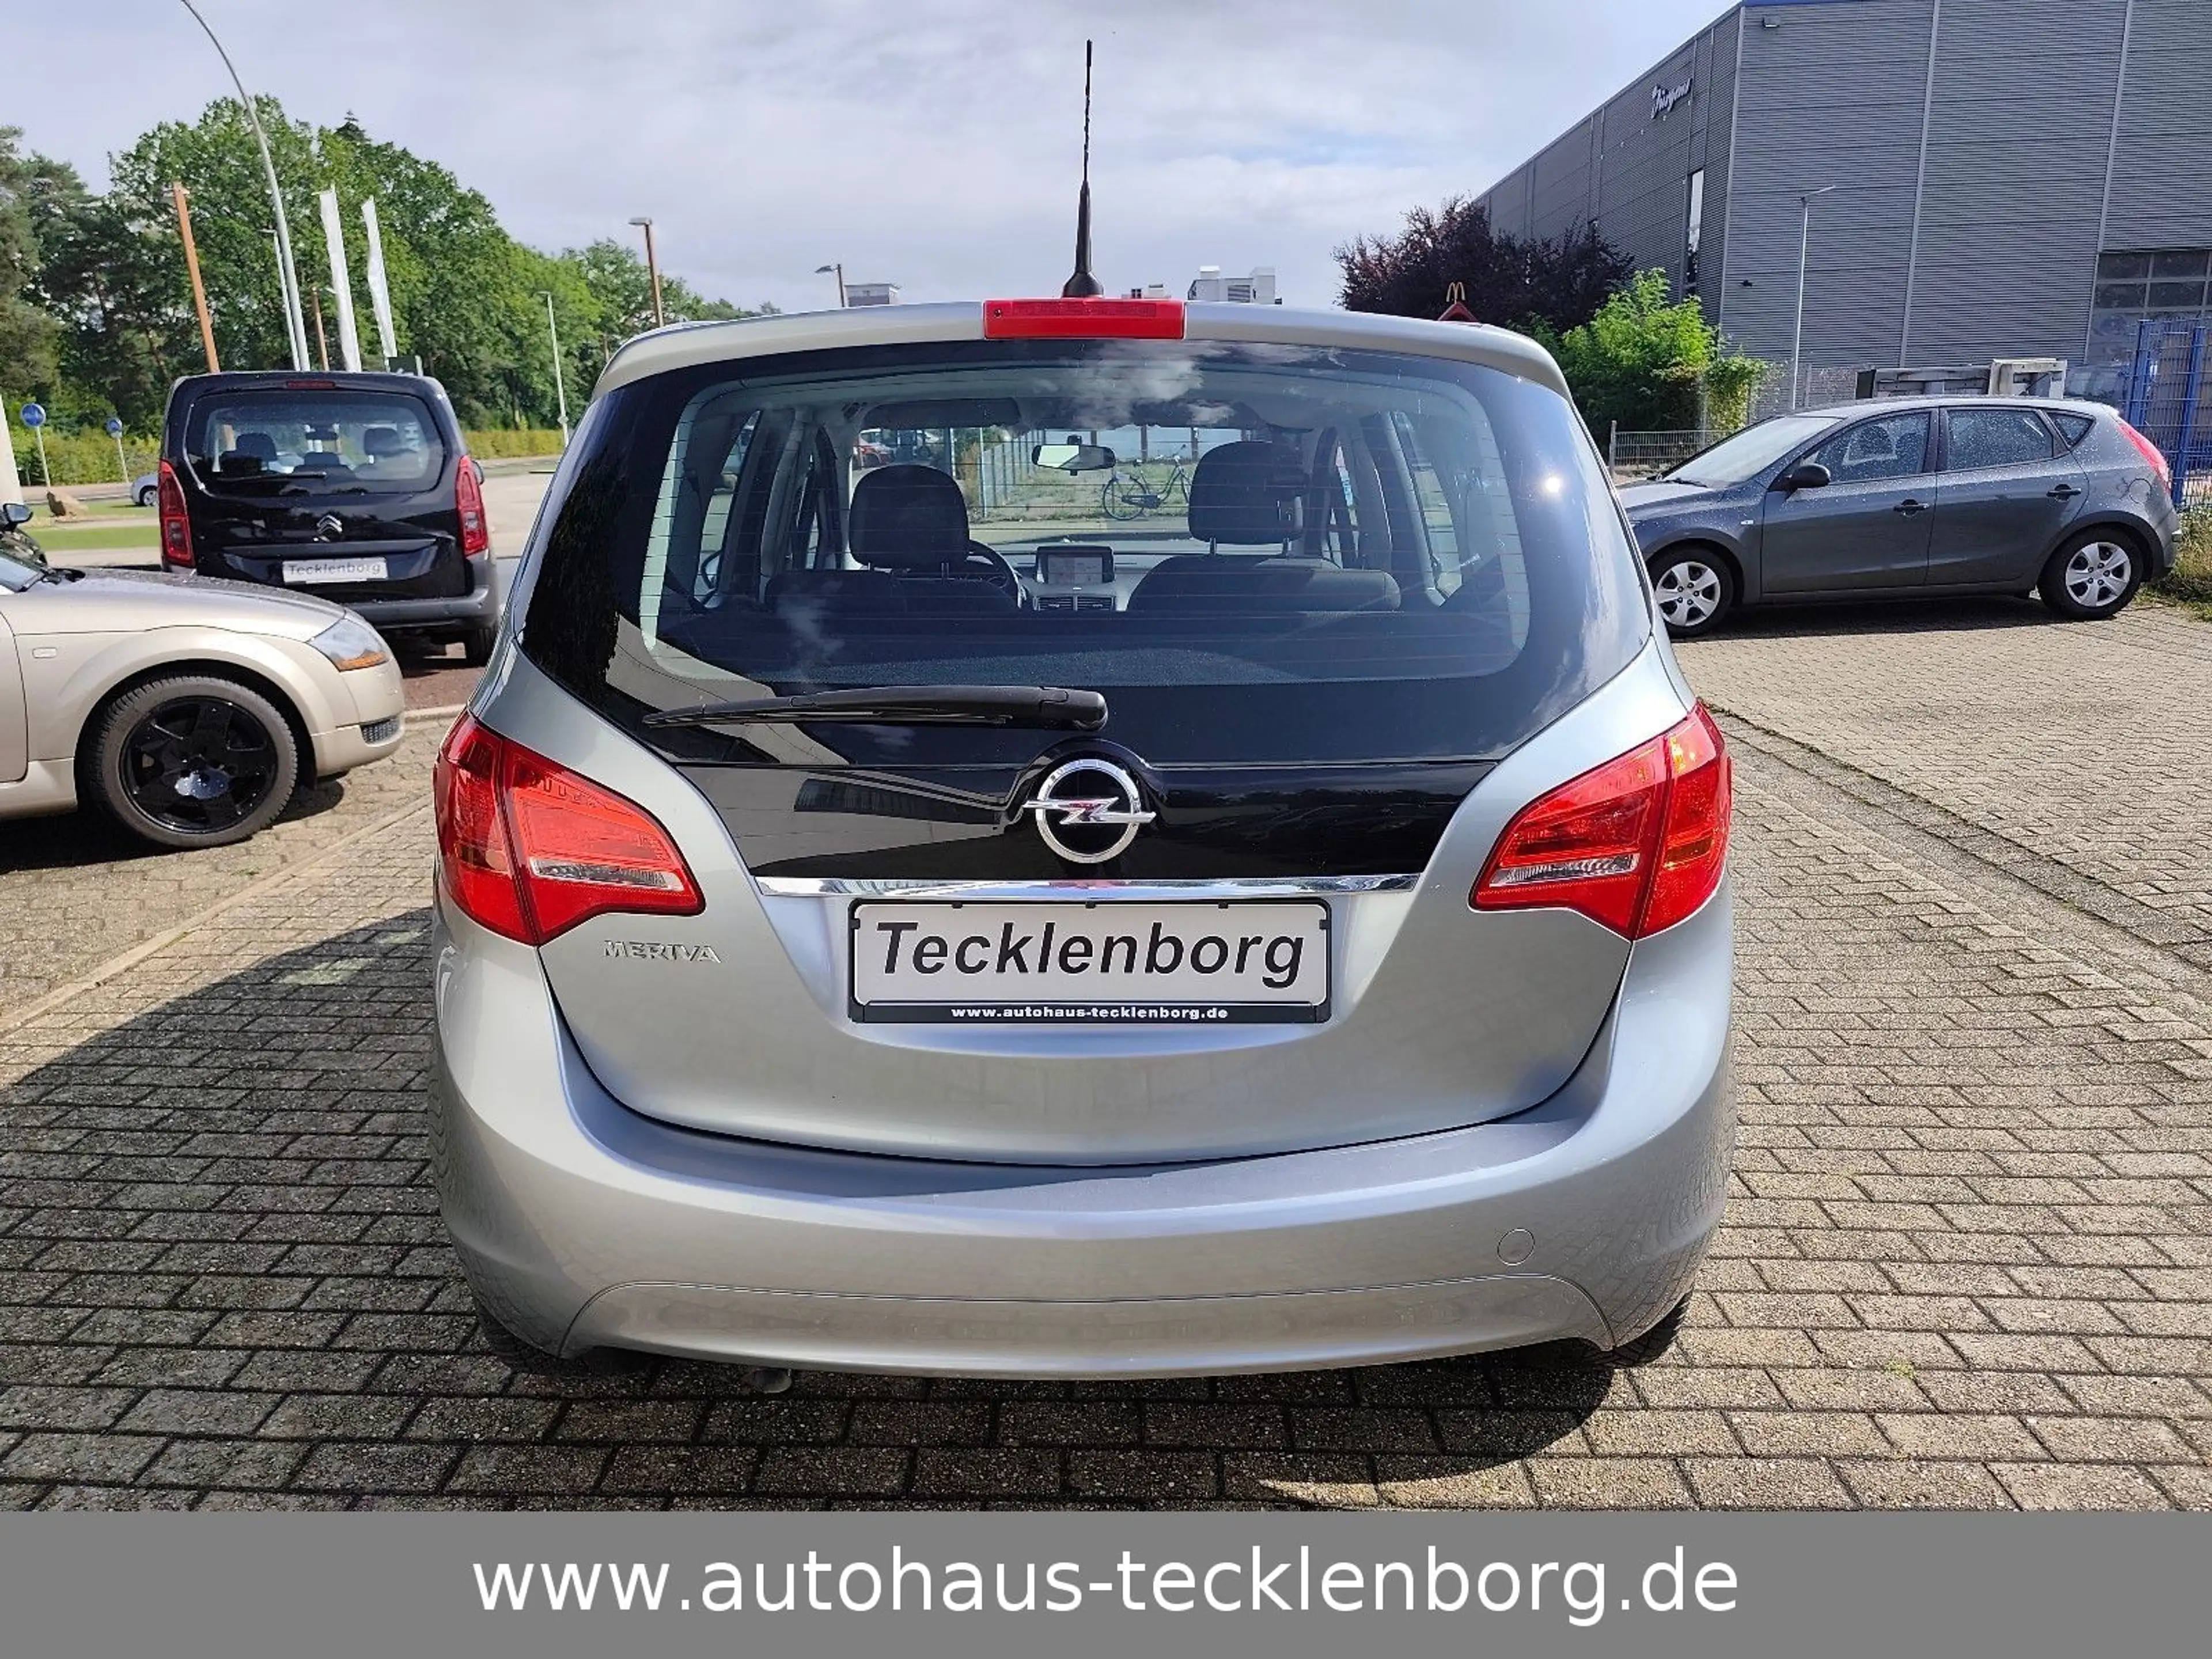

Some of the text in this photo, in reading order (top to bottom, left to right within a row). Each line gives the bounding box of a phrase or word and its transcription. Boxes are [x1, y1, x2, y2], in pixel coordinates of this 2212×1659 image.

[288, 562, 381, 575] Tecklenborg
[604, 940, 721, 963] MERIVA
[876, 922, 1304, 988] Tecklenborg
[950, 1006, 1228, 1020] www.autohaus-tecklenborg.de
